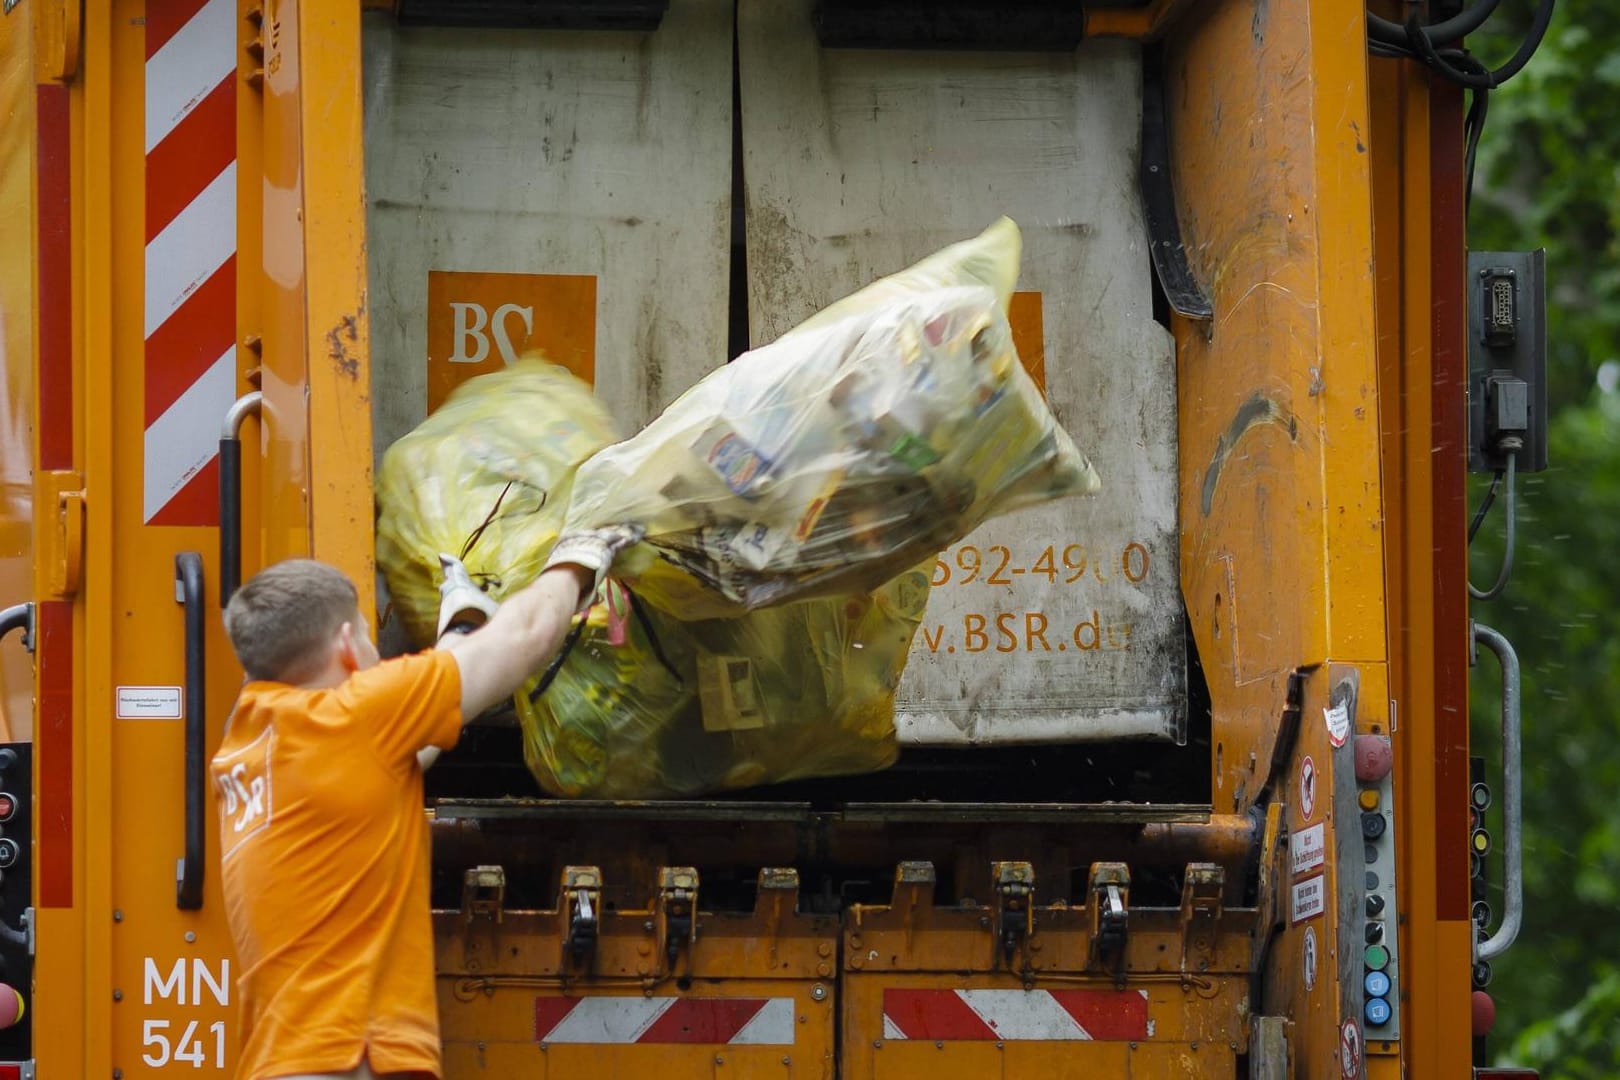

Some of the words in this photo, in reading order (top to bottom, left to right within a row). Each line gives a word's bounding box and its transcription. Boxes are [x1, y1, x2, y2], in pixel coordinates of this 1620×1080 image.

[448, 302, 535, 368] BS
[218, 763, 264, 832] BSR
[144, 957, 230, 1006] MN
[142, 1019, 225, 1069] 541
